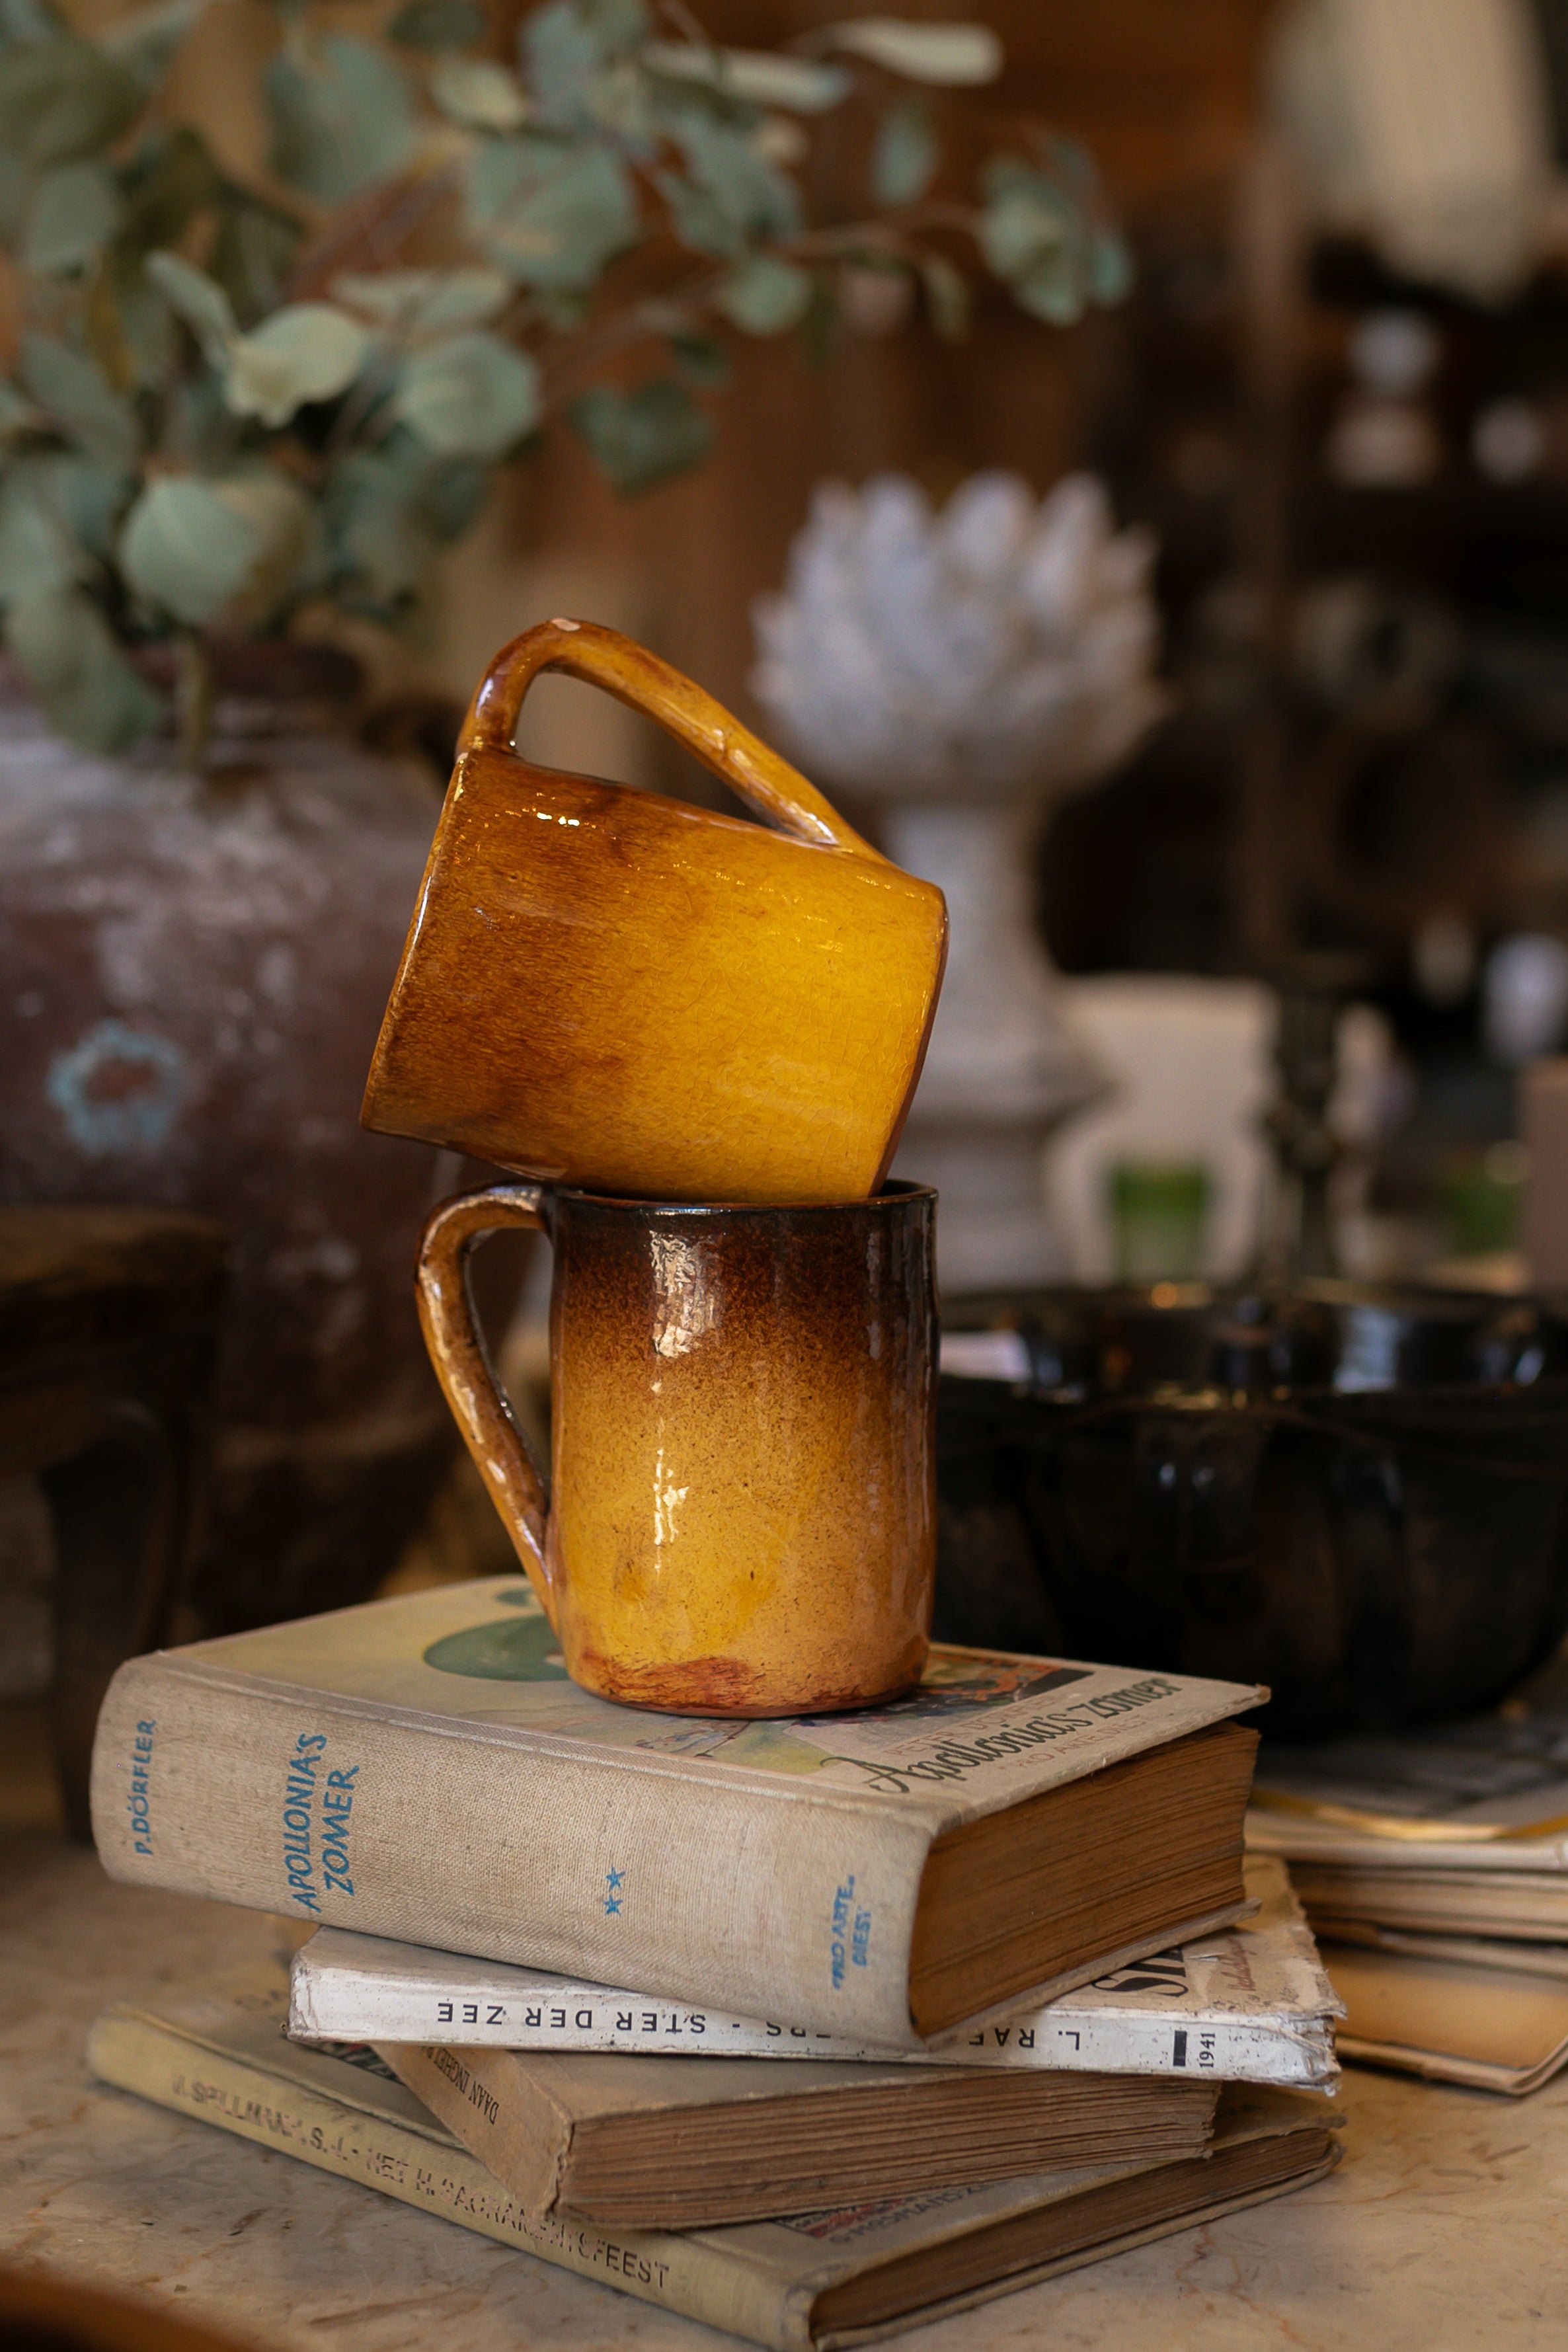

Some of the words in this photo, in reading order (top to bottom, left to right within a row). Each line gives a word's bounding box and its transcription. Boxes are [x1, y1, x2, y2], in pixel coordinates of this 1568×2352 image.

[1066, 1677, 1183, 1719] zomer
[283, 1733, 327, 1913] APOLLONIA'S
[321, 1764, 360, 1896] ZOMER
[438, 2002, 504, 2025] ZEE
[525, 2007, 593, 2029] DER
[615, 2011, 707, 2034] STER
[1058, 2031, 1079, 2051] L.
[1198, 2031, 1216, 2068] 1941
[468, 2080, 500, 2125] DAAN
